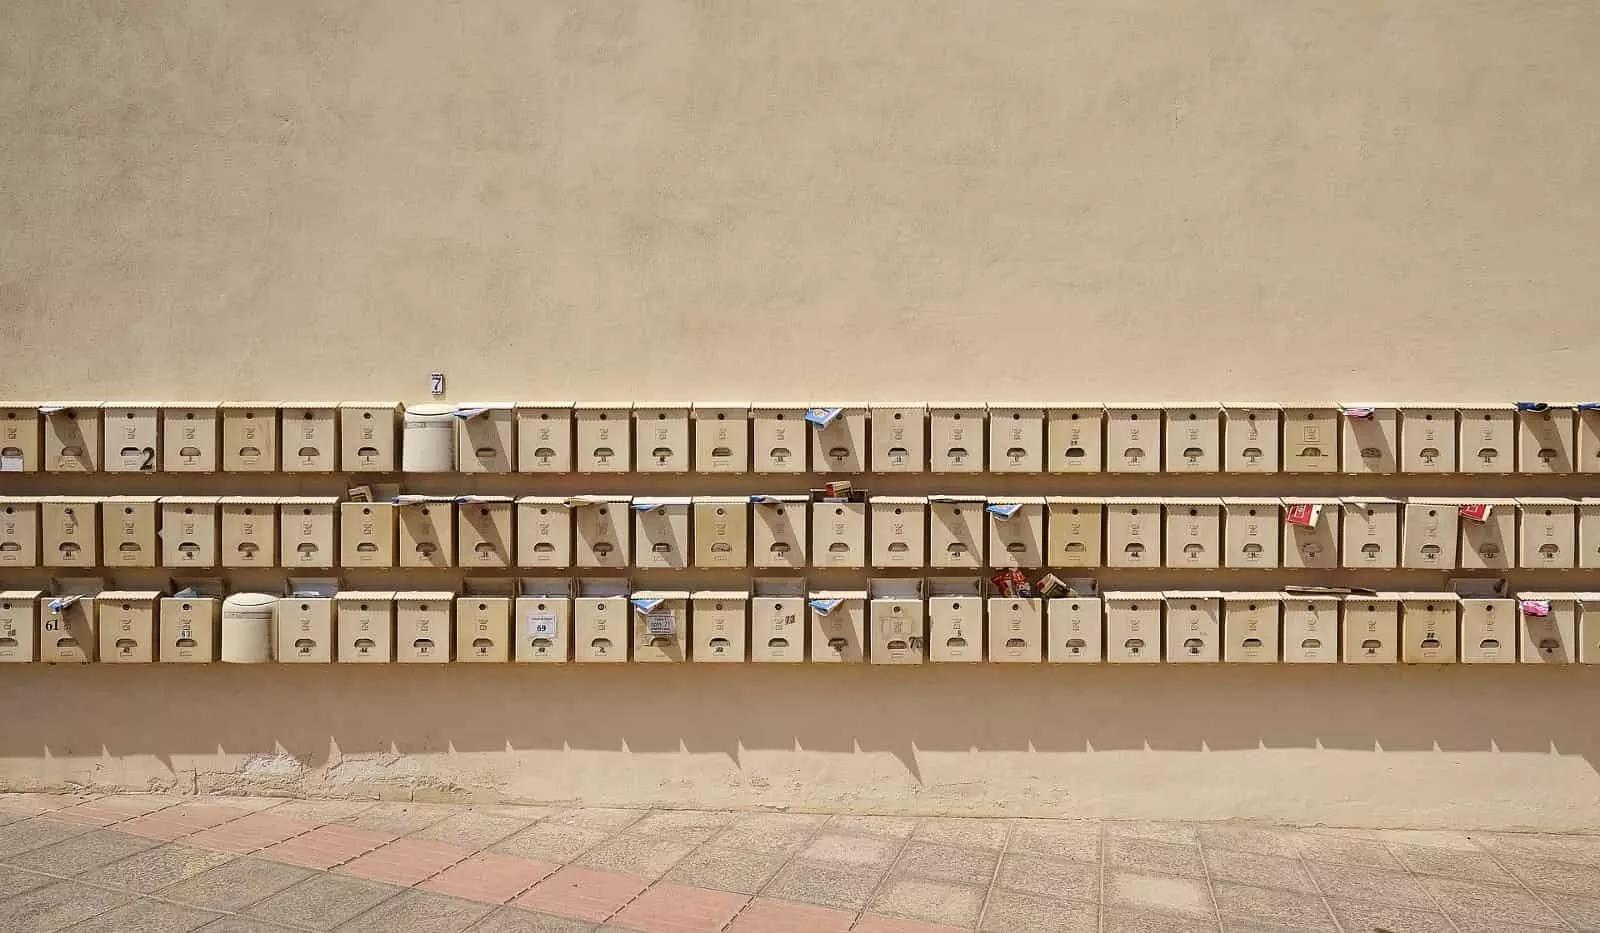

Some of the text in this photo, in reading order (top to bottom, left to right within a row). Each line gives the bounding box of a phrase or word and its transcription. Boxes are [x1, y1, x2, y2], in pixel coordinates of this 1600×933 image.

[432, 377, 441, 391] 7
[141, 447, 155, 471] 2
[46, 619, 59, 632] 61
